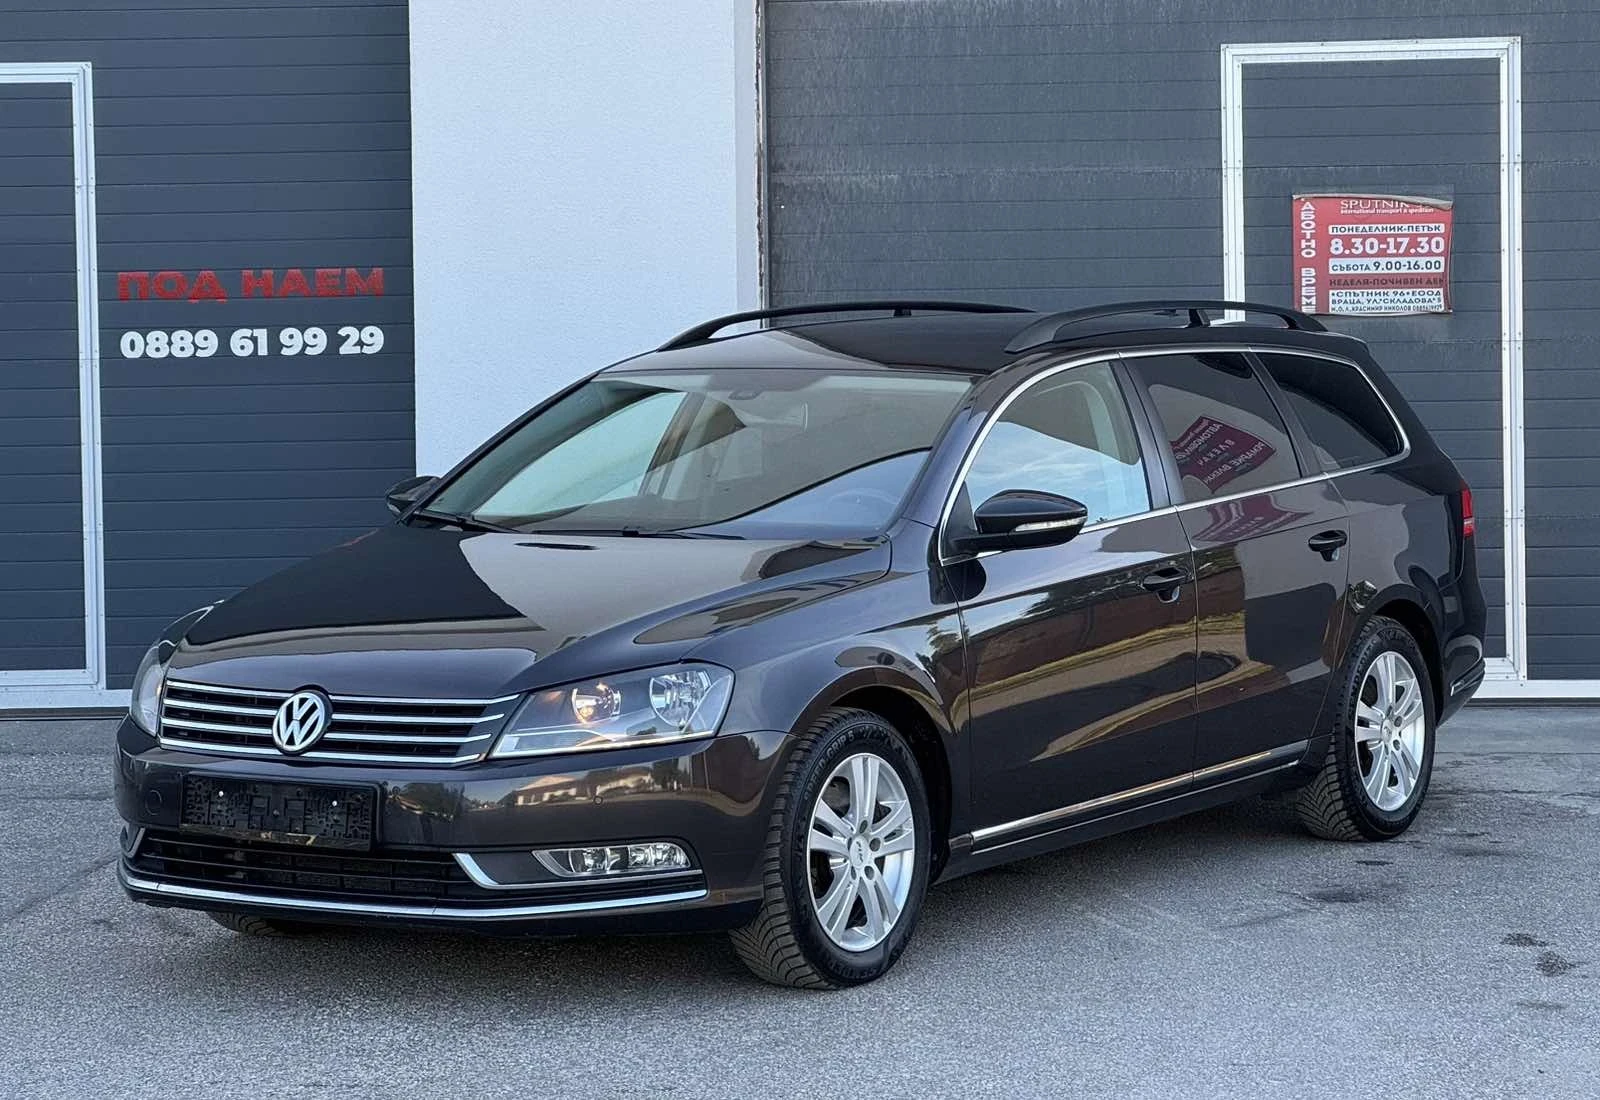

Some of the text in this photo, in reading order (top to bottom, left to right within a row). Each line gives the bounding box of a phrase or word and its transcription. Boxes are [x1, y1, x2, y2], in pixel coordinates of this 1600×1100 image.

[1301, 198, 1316, 258] АБОТНО
[1331, 225, 1441, 234] ПОНЕДЕЛНИК-ПЕТЪК
[1330, 237, 1445, 255] 8.30-17.30
[1331, 260, 1441, 272] СЪБОТА 9.00-16.00
[118, 267, 385, 304] ПОД НАЕМ
[1329, 278, 1423, 287] НЕДЕЛЯ-ПОЧИВЕН
[120, 325, 385, 359] 0889 61 99 29
[272, 692, 326, 752] VW
